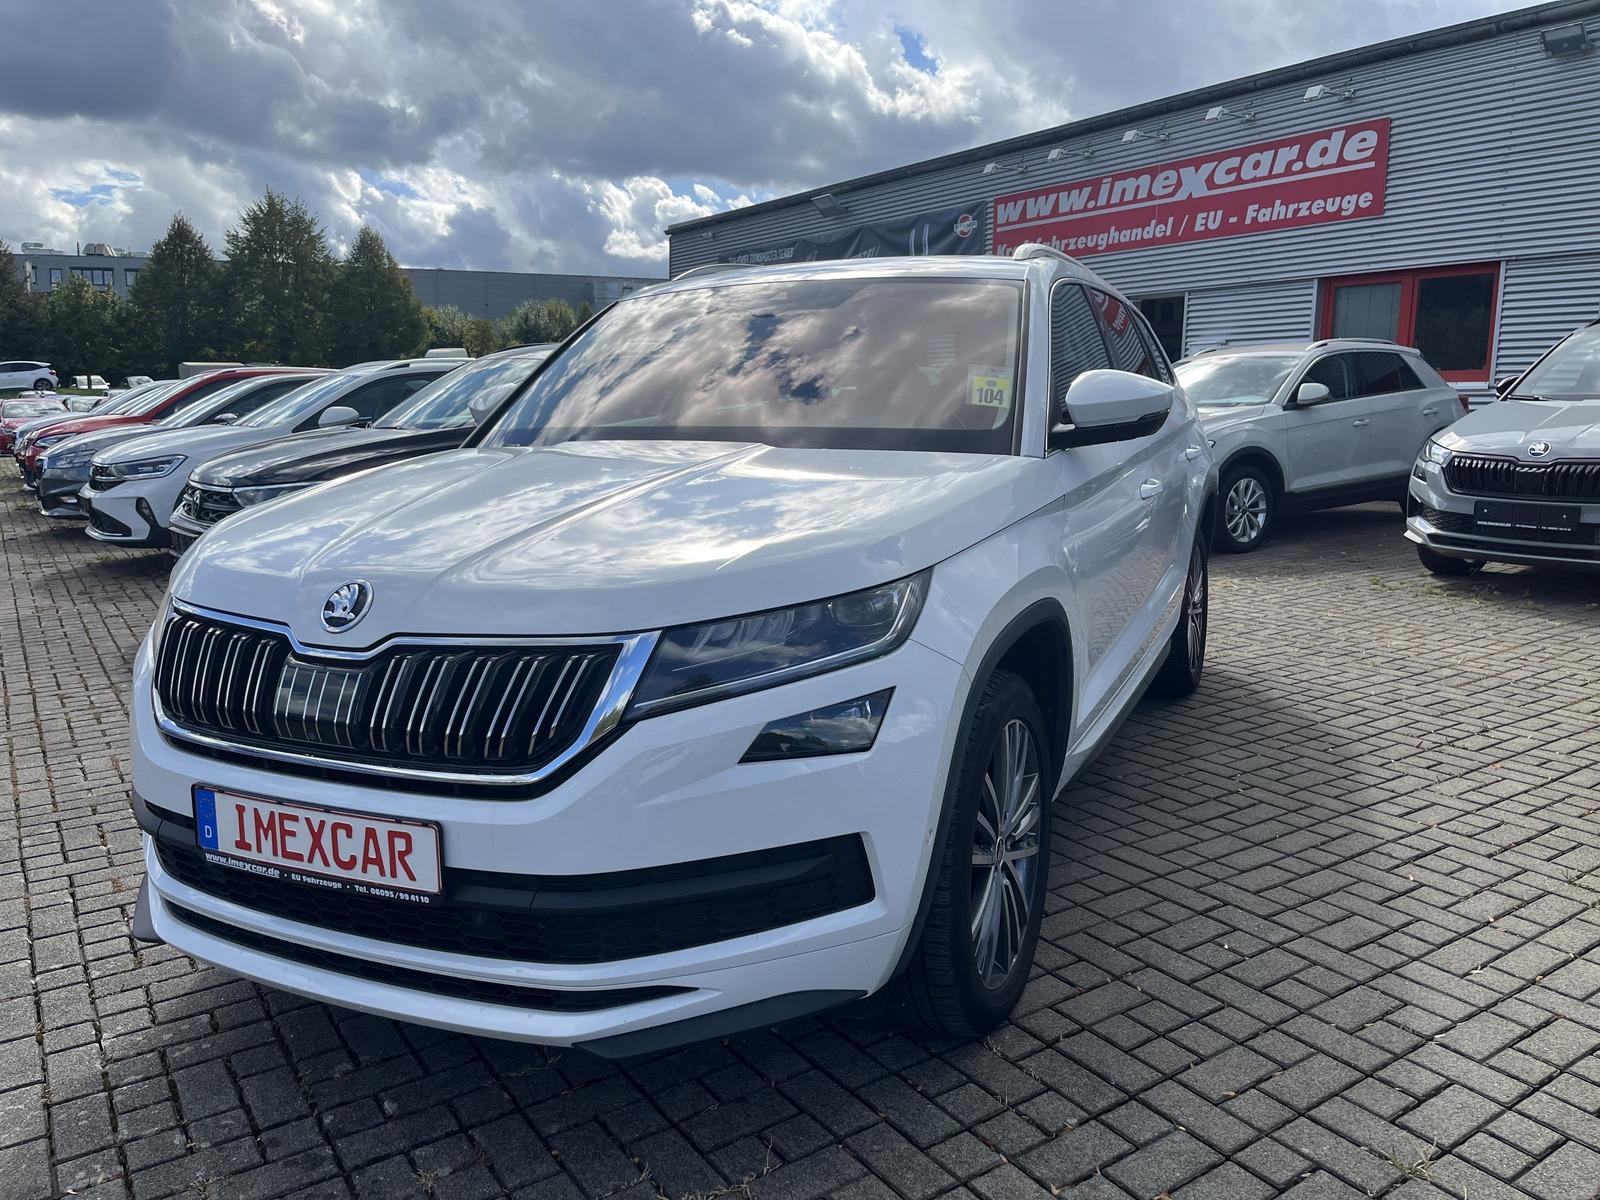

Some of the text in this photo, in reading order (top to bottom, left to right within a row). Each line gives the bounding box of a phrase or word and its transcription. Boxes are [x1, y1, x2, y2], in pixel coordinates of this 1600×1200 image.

[997, 217, 1174, 256] Krhrzeughandel
[1194, 210, 1223, 232] EU
[1245, 191, 1373, 225] Fahrzeuge
[976, 388, 1004, 405] 104
[204, 825, 213, 839] D
[234, 803, 417, 882] IMEXCAR
[291, 873, 301, 881] EU
[302, 875, 343, 889] Fahrzeuge
[354, 884, 369, 894] Tel.
